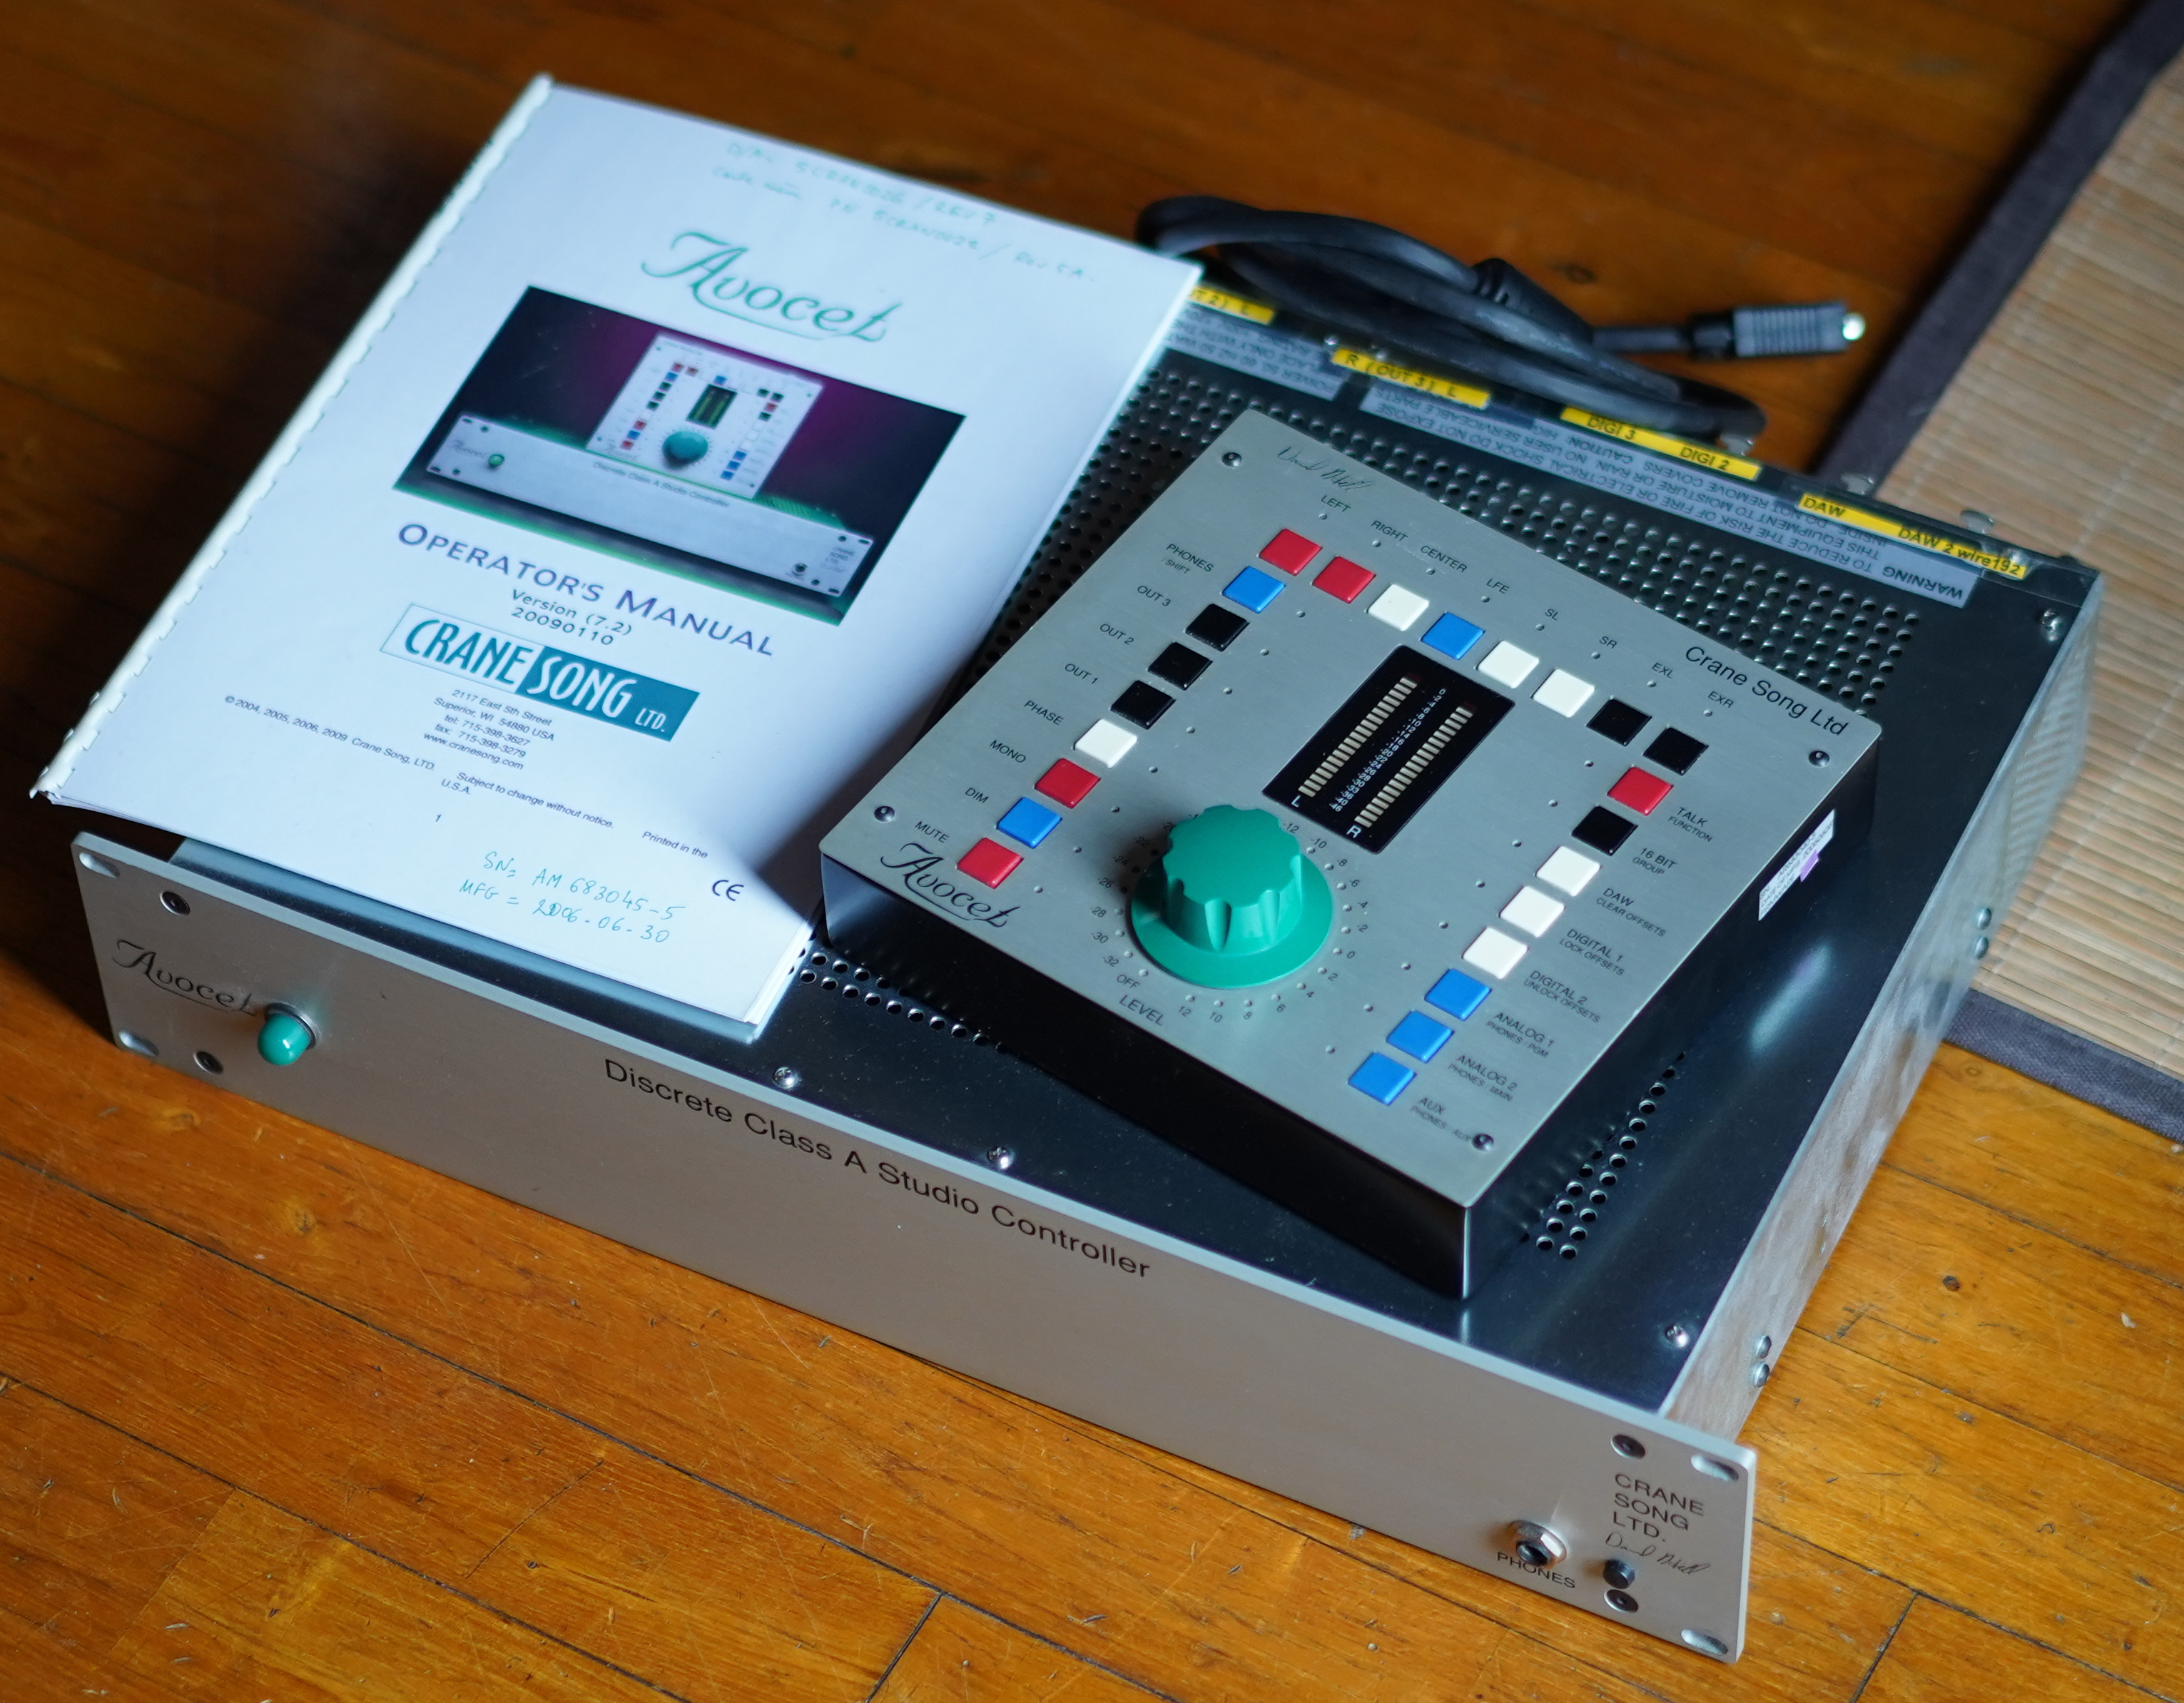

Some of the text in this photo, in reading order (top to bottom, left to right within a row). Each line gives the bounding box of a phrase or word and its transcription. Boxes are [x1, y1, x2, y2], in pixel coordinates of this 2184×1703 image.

[641, 231, 903, 343] Avocet
[1345, 352, 1359, 367] R
[1446, 384, 1457, 398] L
[1585, 415, 1730, 470] DIGI 3 DIGI 2
[1641, 461, 1770, 509] REMOVE COVERS
[1320, 494, 1351, 513] LEFT
[1371, 520, 1409, 542] RIGHT
[1491, 441, 1963, 599] WARNING TO REDUCE THE RISK OF FIRE OR ELECTRICAL SHOCK
[1656, 480, 1882, 559] THIS EQUIPMENT MOISTURE
[1802, 496, 2021, 576] DAW DAW 2 wire192
[1165, 543, 1214, 572] PHONES
[1421, 545, 1468, 574] CENTER
[398, 523, 773, 656] OPERATOR'S MANUAL
[1137, 586, 1172, 607] OUT 3
[1485, 578, 1510, 595] LFE
[512, 589, 633, 637] Version (7.2)
[512, 608, 615, 646] 20090110
[1545, 609, 1560, 621] SL
[1099, 623, 1134, 645] OUT 2
[1599, 636, 1618, 649] SR
[405, 619, 666, 733] CRANE SONG LTD.
[1065, 663, 1091, 681] OUT
[1651, 663, 1673, 679] EXL
[1685, 646, 1849, 736] Crane Song Ltd
[1707, 691, 1734, 709] EXR
[434, 698, 554, 741] Superior, WI 54880 USA
[452, 689, 552, 726] 2117 East 5th Street
[1024, 700, 1064, 725] PHASE
[263, 708, 290, 723] 2005,
[293, 718, 319, 733] 2006,
[322, 728, 348, 742] 2009
[351, 738, 382, 753] Crane
[383, 748, 410, 764] Song,
[413, 758, 435, 771] LTD.
[435, 723, 527, 758] fax: 715-398-3279
[444, 714, 531, 747] tel: 715-398-3627
[424, 732, 524, 771] www.cranesong.com
[989, 740, 1026, 763] MONO
[441, 778, 471, 795] U.S.A.
[965, 788, 989, 803] DIM
[456, 772, 708, 859] Subject to change without notice. Printed in the
[1291, 795, 1301, 808] L
[435, 814, 442, 823] 1
[915, 820, 950, 843] MUTE
[1346, 825, 1361, 838] R
[1667, 816, 1713, 843] FUNCTION
[1677, 807, 1708, 828] TALK
[1632, 857, 1665, 876] GROUP
[1640, 848, 1677, 869] 16 BIT
[459, 878, 499, 900] MFG
[880, 843, 1020, 927] Avocet
[1603, 888, 1635, 907] DAW
[1596, 898, 1666, 937] CLEAR OFFSETS
[1346, 950, 1356, 959] 0
[1560, 939, 1625, 976] LOCK OFFSETS
[1567, 929, 1612, 958] DIGITAL
[113, 939, 256, 1016] Avocet
[1117, 974, 1141, 990] OFF
[1328, 972, 1339, 982] 2
[1530, 970, 1588, 1005] DIGITAL 2
[1276, 1005, 1286, 1013] 6
[1306, 990, 1315, 999] 4
[1523, 979, 1600, 1023] UNLOCK OFFSETS
[1119, 995, 1164, 1027] LEVEL
[1178, 1007, 1192, 1017] 12
[1211, 1012, 1223, 1023] 10
[1244, 1012, 1252, 1020] 8
[1487, 1021, 1523, 1044] PHONES
[1493, 1012, 1544, 1043] ANALOG
[1448, 1064, 1485, 1087] PHONES
[1456, 1055, 1518, 1091] ANALOG 2
[1418, 1097, 1446, 1115] AUX
[605, 1059, 1149, 1278] Discrete Class A Studio Controller
[1615, 1473, 1704, 1517] CRANE
[1614, 1493, 1689, 1530] SONG
[1613, 1512, 1665, 1542] LTD.
[1497, 1552, 1576, 1589] PHONES
